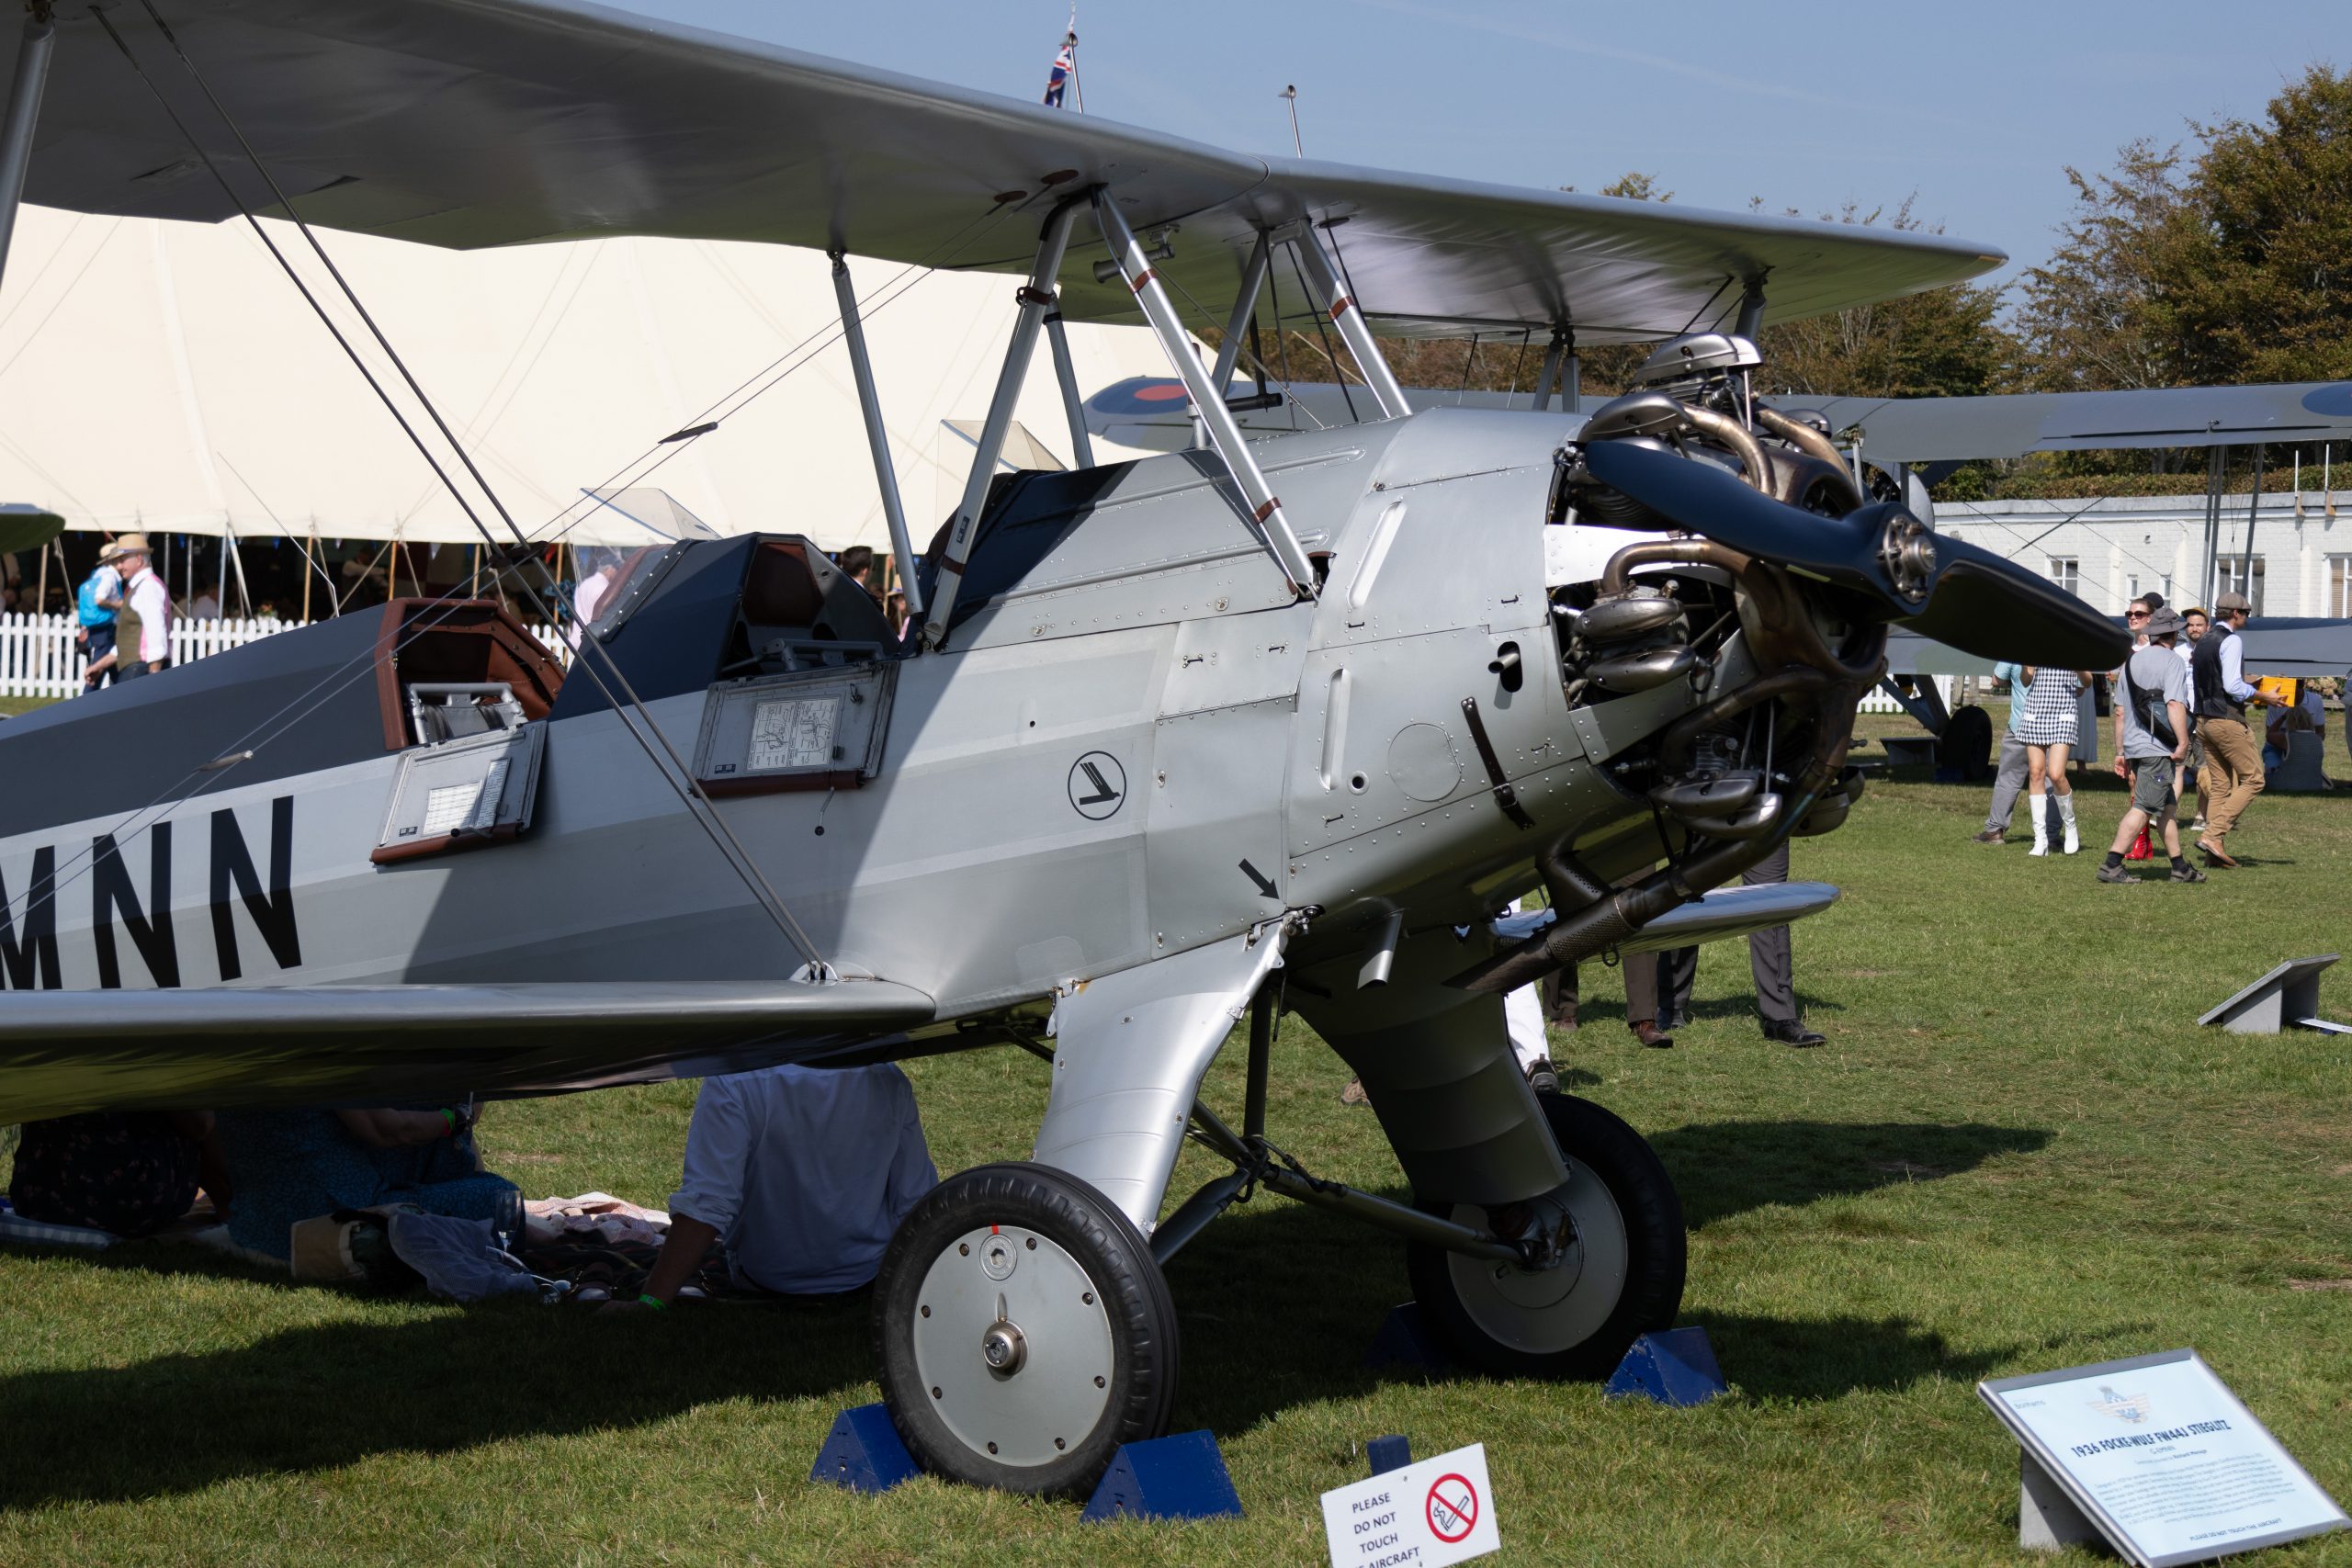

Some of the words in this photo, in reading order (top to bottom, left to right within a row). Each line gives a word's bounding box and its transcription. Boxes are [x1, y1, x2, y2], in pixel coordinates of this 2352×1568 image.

[0, 795, 302, 990] MNN
[2071, 1442, 2101, 1458] 1936
[2099, 1434, 2155, 1451] FOCKE-WULF
[2154, 1427, 2189, 1442] FW44J
[2188, 1419, 2232, 1435] STIEGLITZ
[1351, 1492, 1391, 1513] PLEASE
[1353, 1520, 1370, 1534] DO
[1373, 1511, 1396, 1528] NOT
[1360, 1531, 1398, 1553] TOUCH
[1368, 1546, 1419, 1568] AIRCRAFT
